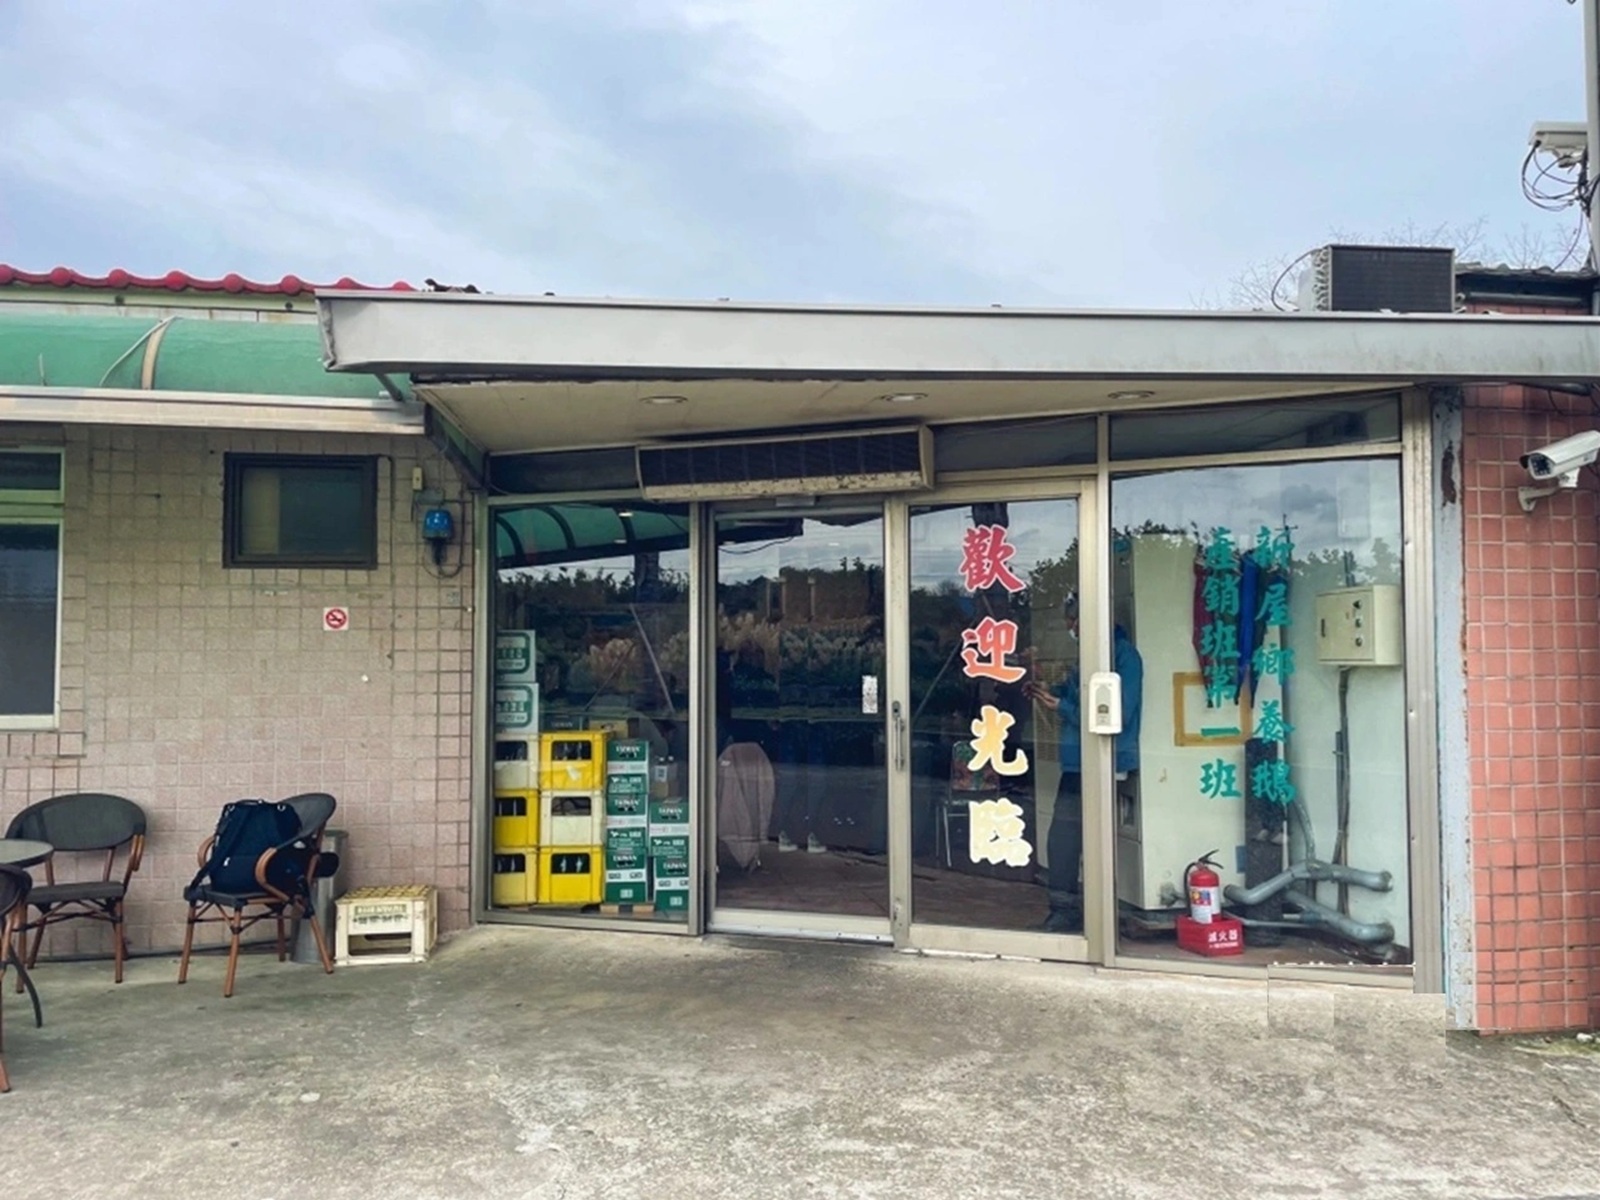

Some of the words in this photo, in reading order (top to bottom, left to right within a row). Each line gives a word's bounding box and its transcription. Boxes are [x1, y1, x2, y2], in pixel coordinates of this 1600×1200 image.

[958, 523, 1033, 868] 歡迎光臨
[1252, 525, 1296, 806] 新屋鄉養鵝
[1208, 929, 1238, 942] 滅火器
